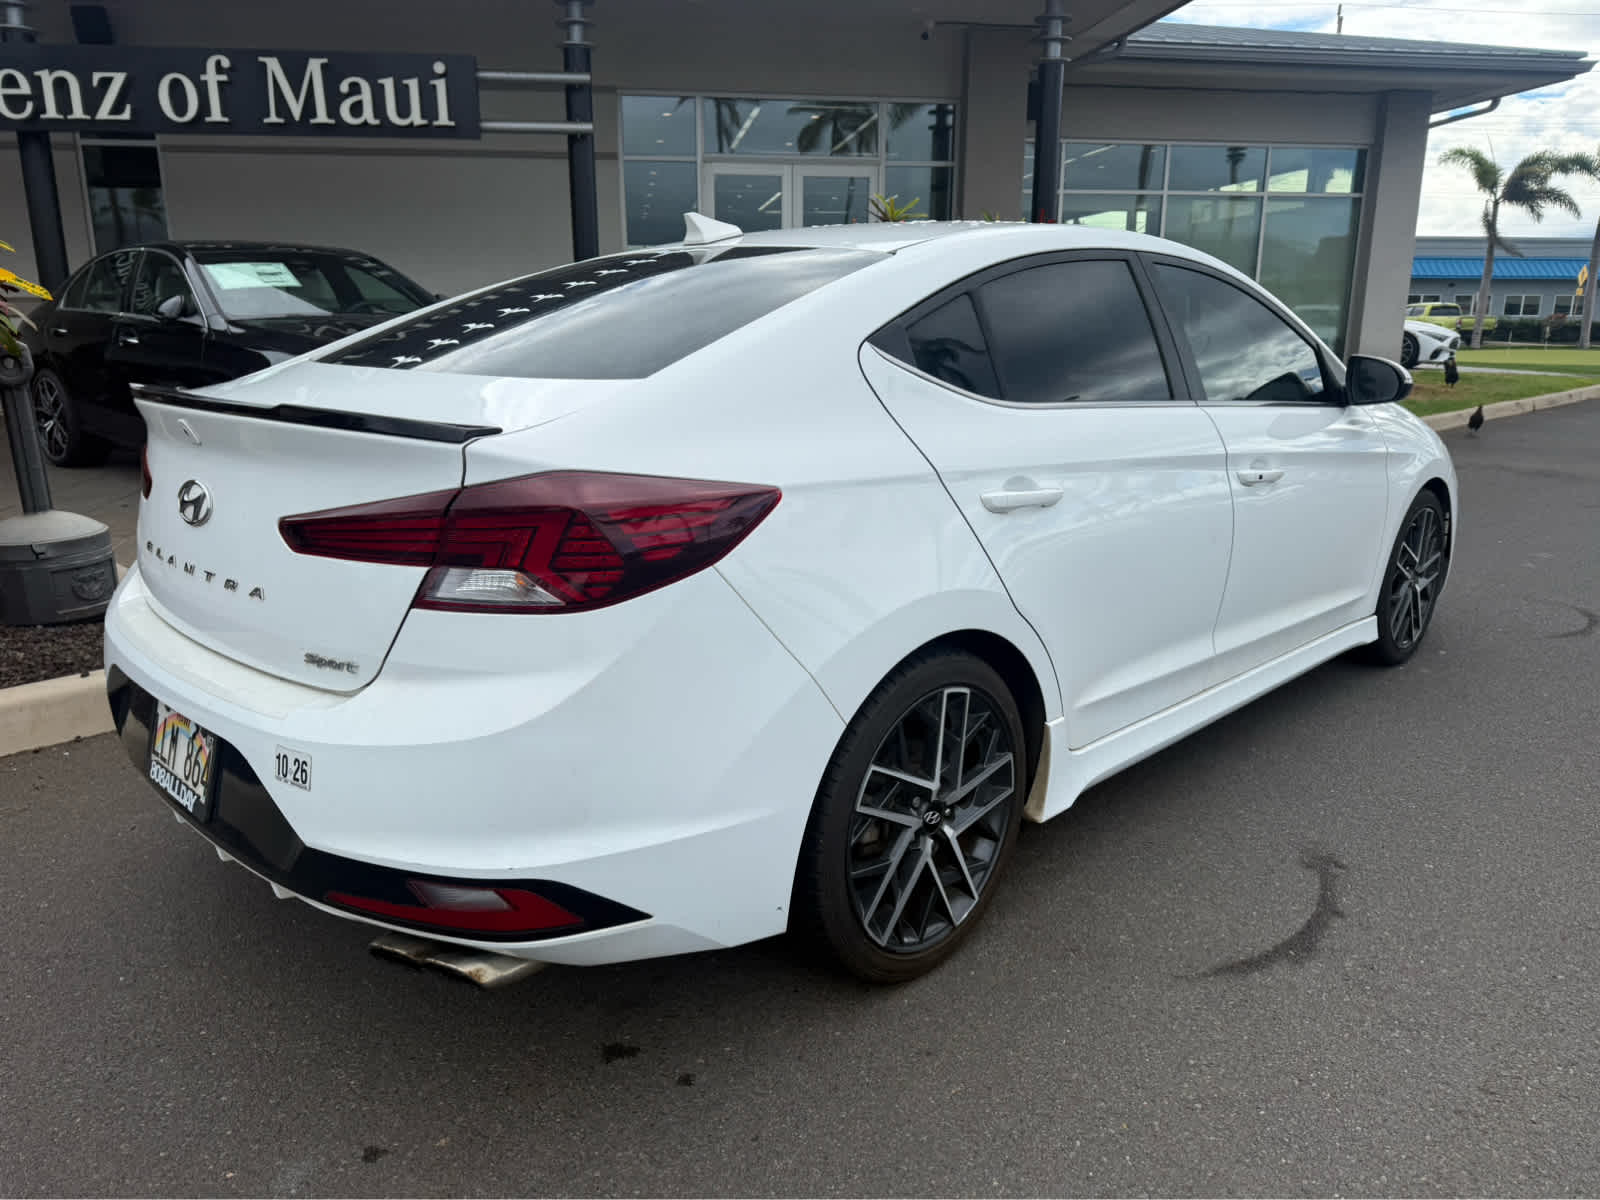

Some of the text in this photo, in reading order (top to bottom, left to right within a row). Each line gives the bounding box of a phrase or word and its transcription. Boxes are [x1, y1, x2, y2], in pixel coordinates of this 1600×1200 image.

[0, 54, 456, 127] enz of Maui
[146, 540, 265, 601] ELANTRA
[303, 652, 360, 674] Sport
[275, 752, 289, 778] 10
[292, 757, 308, 785] 26
